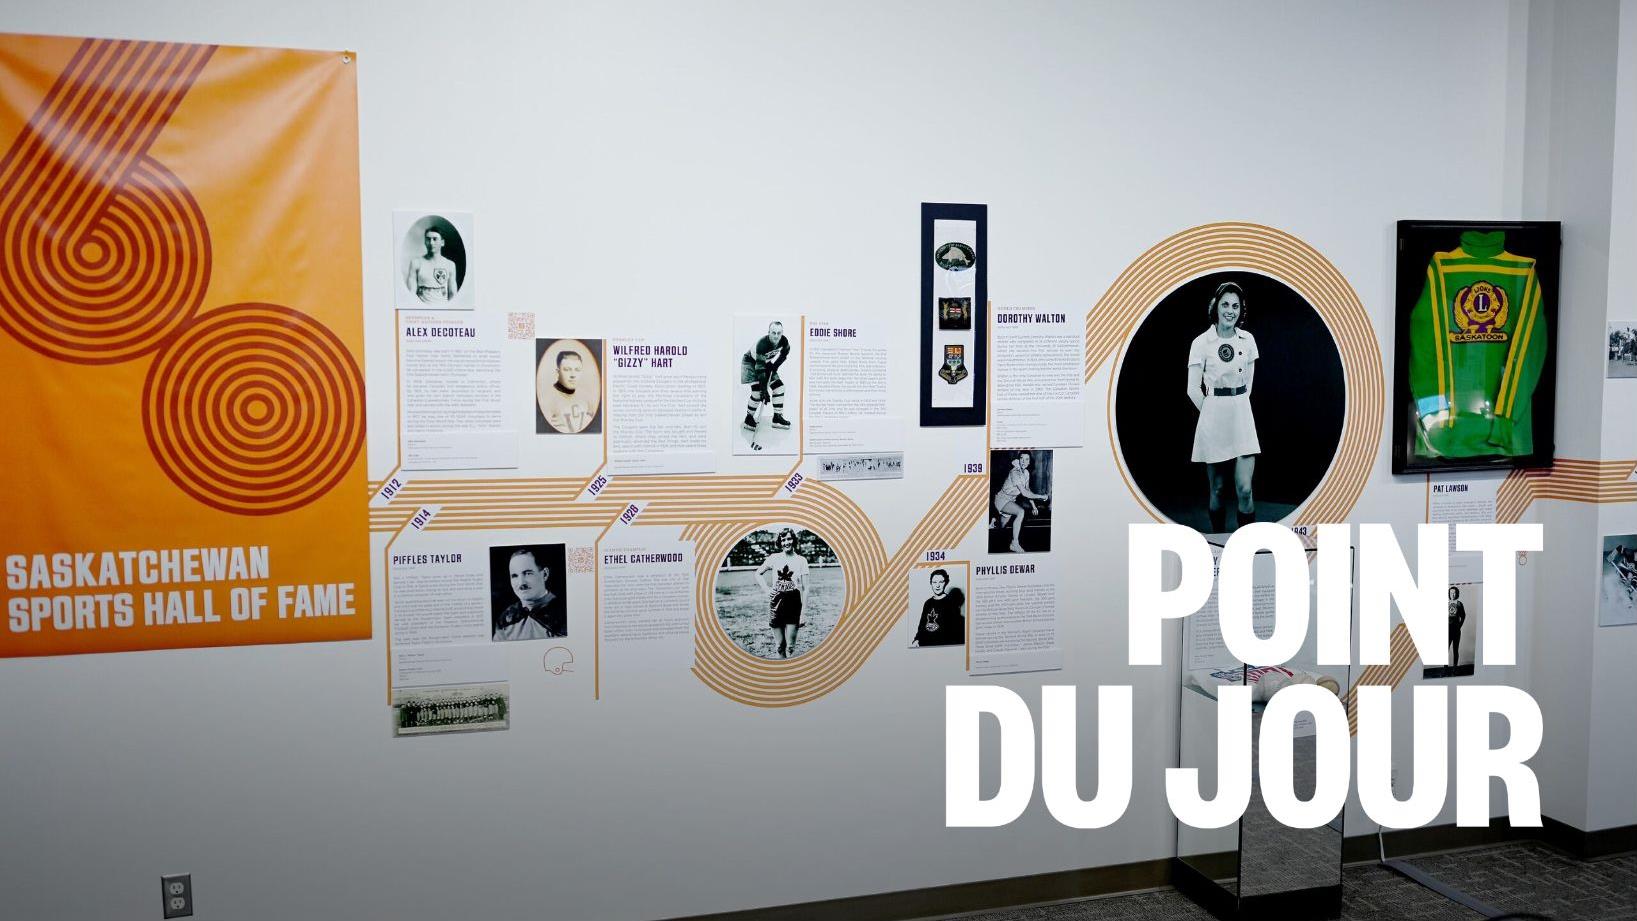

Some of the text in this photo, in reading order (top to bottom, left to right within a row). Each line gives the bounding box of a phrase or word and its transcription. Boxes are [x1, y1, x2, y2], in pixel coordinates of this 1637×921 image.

[1478, 294, 1487, 312] L
[997, 313, 1066, 324] DOROTHY WALTON
[406, 327, 476, 338] ALEX DECOTEAU
[809, 328, 857, 338] EDDIE SHORE
[1455, 333, 1504, 341] SASKATOON
[613, 345, 688, 356] WILFRED HAROLD
[651, 358, 673, 368] HART
[964, 463, 983, 473] 1939
[587, 474, 607, 496] 1925
[785, 472, 803, 492] 1933
[380, 478, 402, 500] 1912
[1433, 484, 1468, 493] PAT LAWSON
[410, 509, 431, 529] 1914
[620, 504, 639, 525] 1928
[393, 554, 462, 565] PIFFLES TAYLOR
[604, 553, 683, 564] ETHEL CATHERWOOD
[926, 551, 946, 561] 1934
[6, 546, 270, 590] SASKATCHEWAN
[975, 564, 1036, 575] PHYLLIS DEWAR
[8, 593, 134, 632] SPORTS
[144, 589, 221, 626] HALL
[231, 587, 269, 621] OF
[277, 583, 356, 619] FAME
